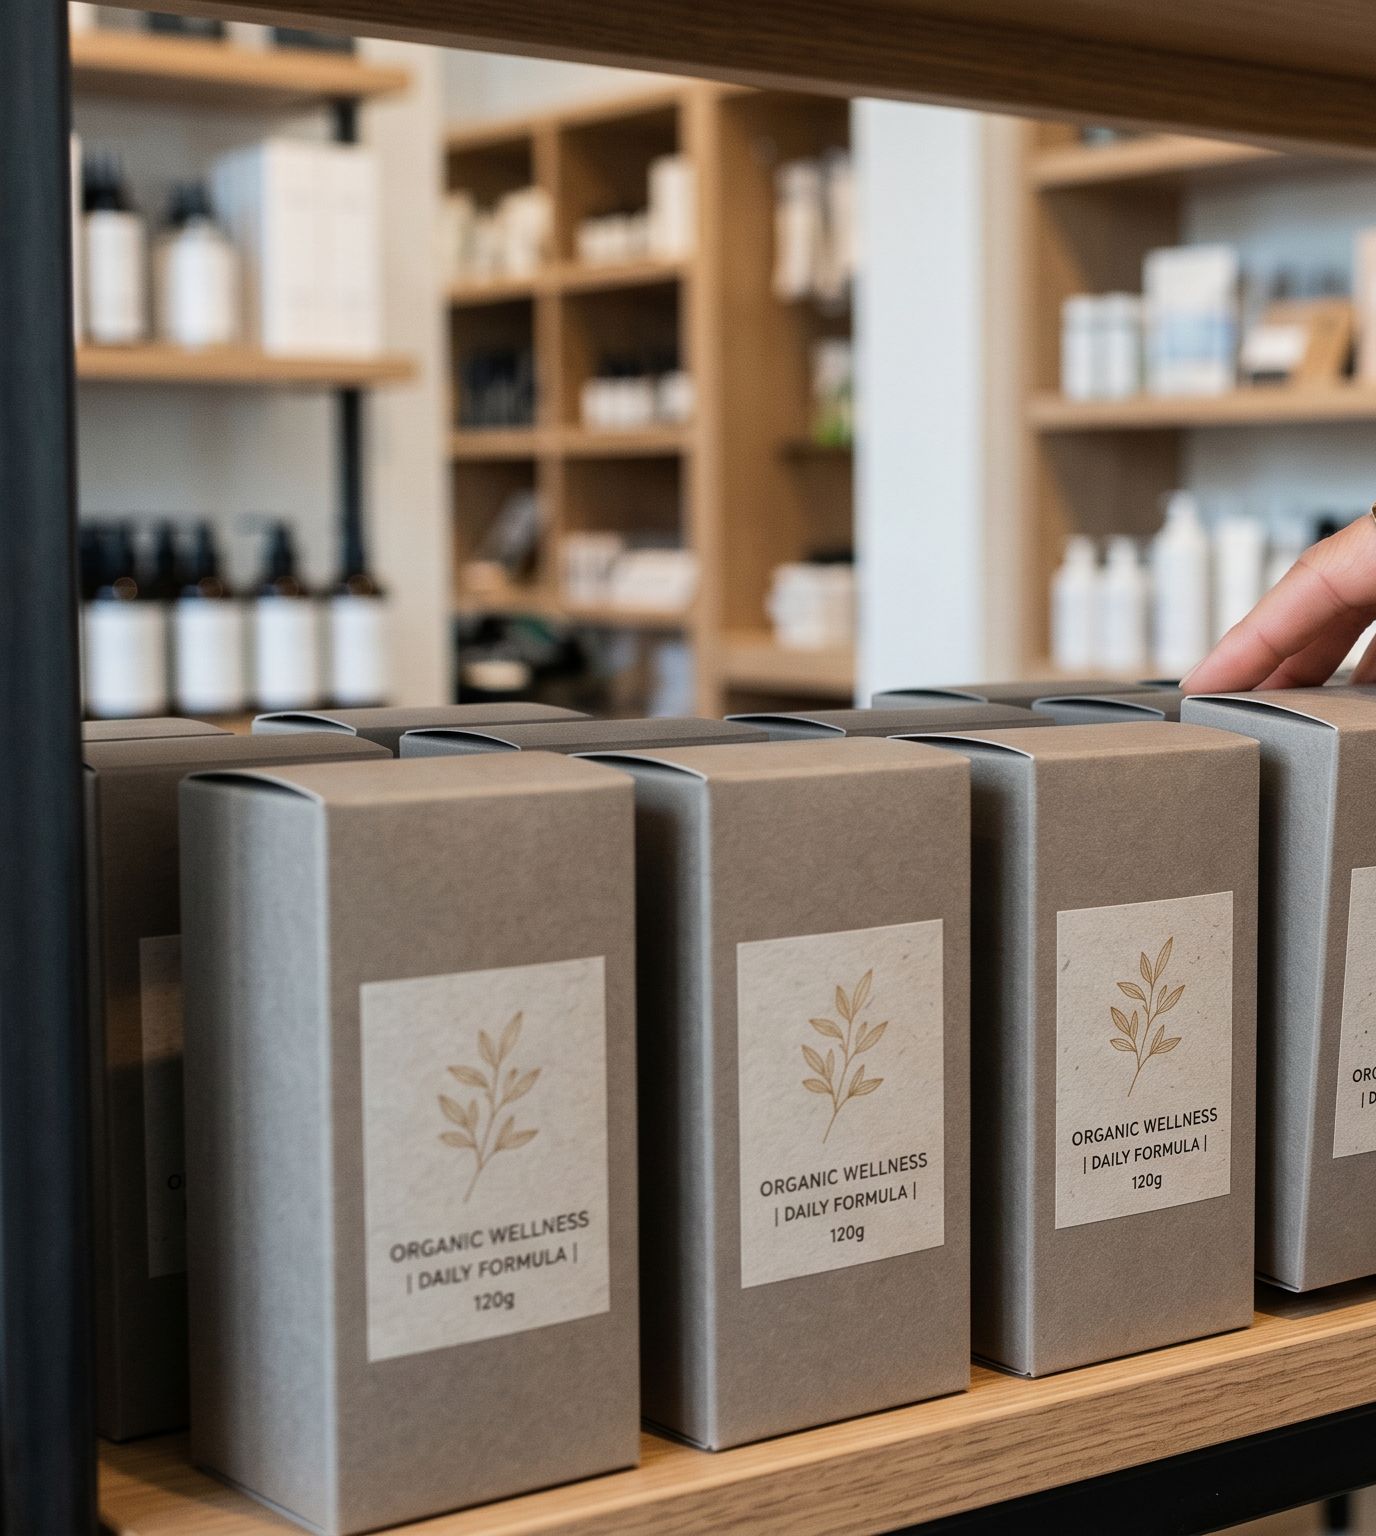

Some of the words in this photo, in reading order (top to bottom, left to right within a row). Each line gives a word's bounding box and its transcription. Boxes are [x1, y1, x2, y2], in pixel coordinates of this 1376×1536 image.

[1071, 1121, 1139, 1146] ORGANIC
[1143, 1107, 1218, 1134] WELLNESS
[1092, 1149, 1130, 1170] DAILY
[1134, 1137, 1200, 1162] FORMULA
[760, 1168, 839, 1197] ORGANIC
[843, 1152, 928, 1182] WELLNESS
[1131, 1173, 1162, 1190] 120g
[784, 1199, 830, 1222] DAILY
[834, 1184, 908, 1213] FORMULA
[389, 1229, 484, 1264] ORGANIC
[488, 1210, 590, 1244] WELLNESS
[830, 1224, 865, 1243] 120g
[418, 1263, 473, 1290] DAILY
[478, 1247, 567, 1279] FORMULA
[473, 1291, 515, 1311] 120g
